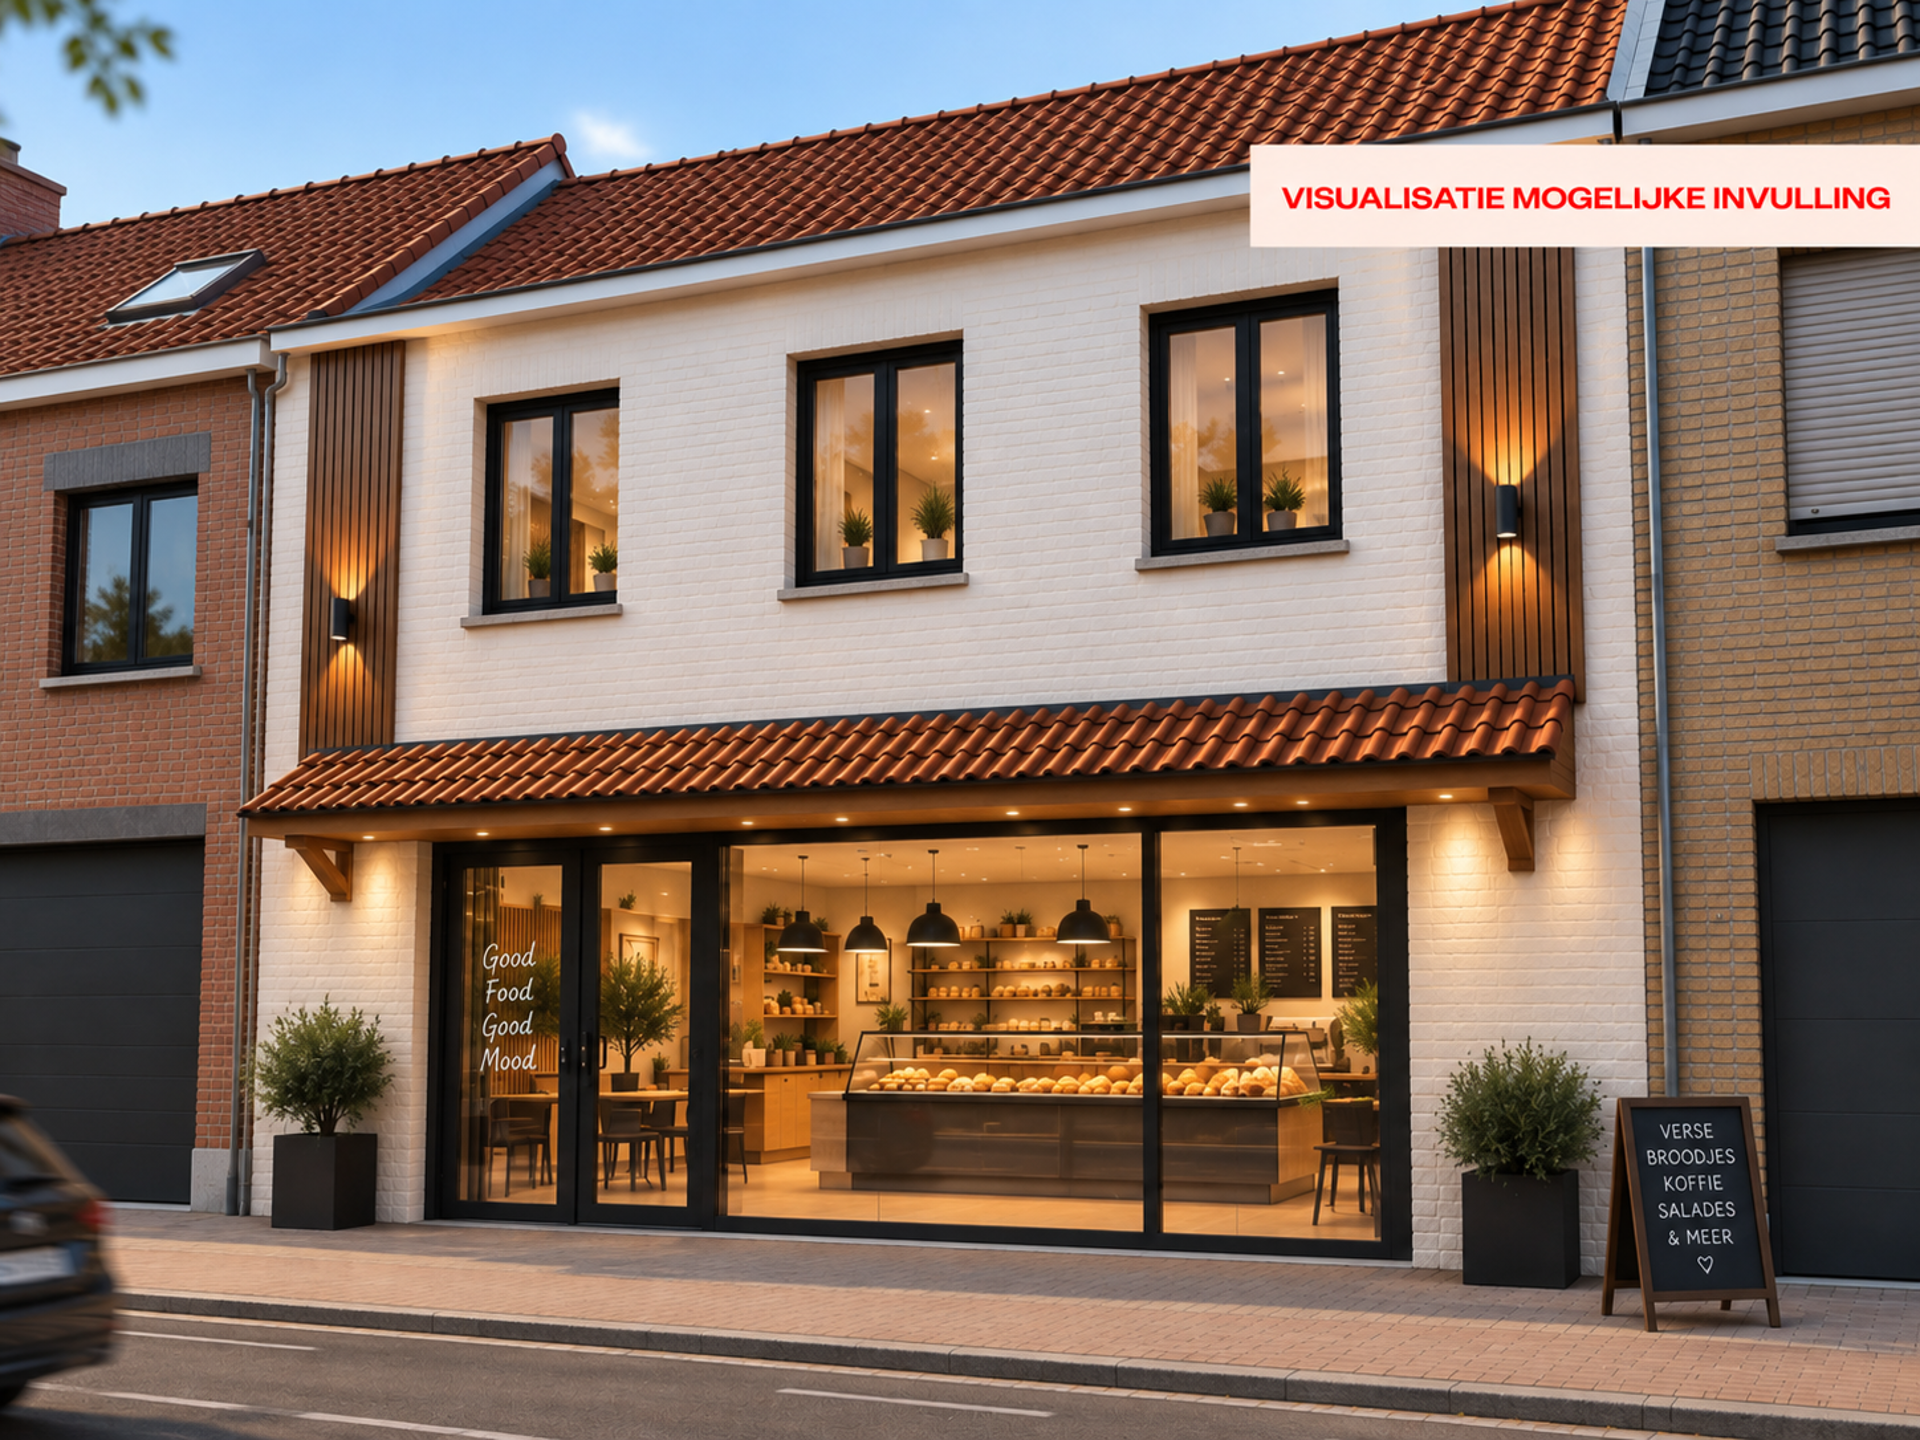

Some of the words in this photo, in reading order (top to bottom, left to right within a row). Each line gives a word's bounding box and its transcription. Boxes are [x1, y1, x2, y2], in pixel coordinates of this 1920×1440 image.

[483, 940, 536, 976] Good
[486, 977, 534, 1004] Food
[482, 1010, 534, 1043] Good
[480, 1043, 537, 1072] Mood
[1660, 1123, 1714, 1139] VERSE
[1647, 1149, 1736, 1165] BROODJES
[1663, 1175, 1724, 1191] KOFFIE
[1659, 1202, 1736, 1219] SALADES
[1668, 1230, 1680, 1246] &
[1686, 1229, 1734, 1245] MEER
